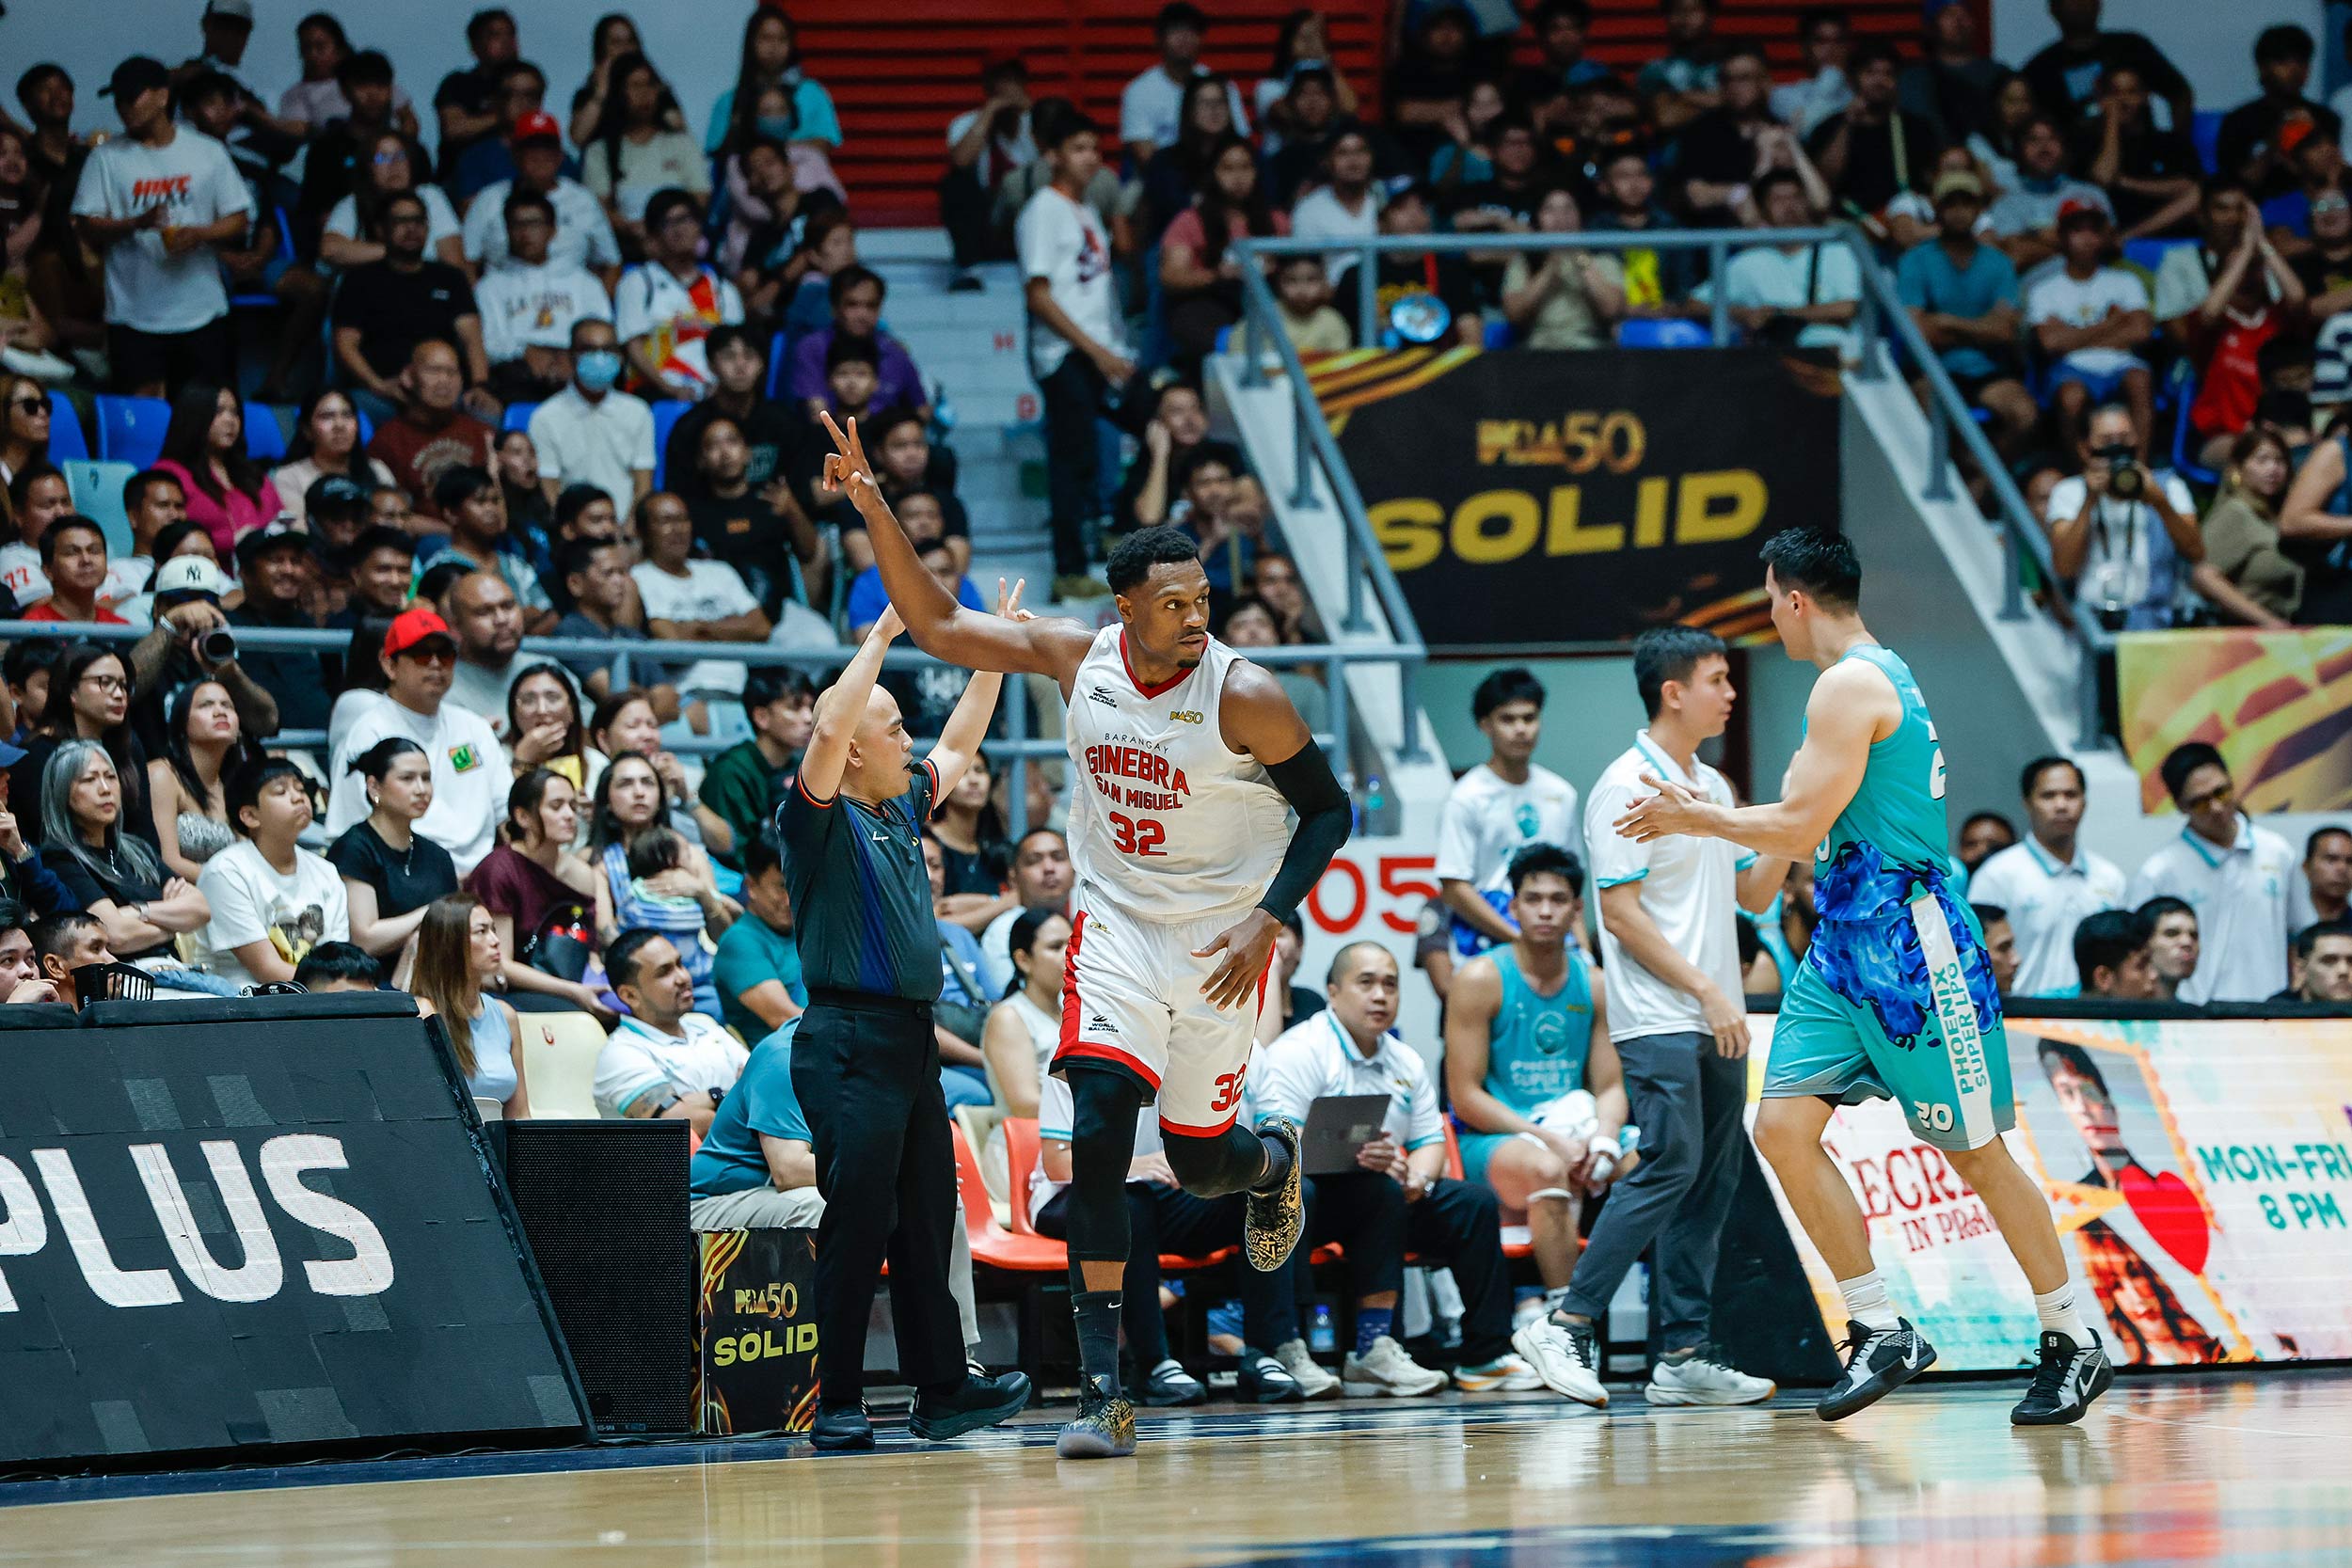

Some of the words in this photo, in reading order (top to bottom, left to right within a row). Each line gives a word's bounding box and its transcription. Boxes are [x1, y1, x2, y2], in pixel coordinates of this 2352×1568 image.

[1367, 468, 1769, 572] SOLID
[1089, 695, 1118, 708] BALANCE
[1092, 691, 1116, 704] WORLD
[1104, 733, 1169, 754] BARANGAY
[1085, 745, 1191, 796] GINEBRA
[1094, 774, 1121, 804] SAN
[1125, 788, 1184, 810] MIGUEL
[1108, 811, 1168, 856] 32
[1932, 967, 1975, 1095] PHOENIX
[1958, 1012, 1988, 1088] SUPER
[1211, 1063, 1247, 1112] 32
[1914, 1100, 1954, 1132] 20
[2196, 1143, 2352, 1182] MON-FRI
[2258, 1193, 2287, 1230] 8
[2286, 1192, 2347, 1229] PM
[1901, 1216, 1933, 1252] IN
[735, 1282, 798, 1319] PBA50
[714, 1323, 818, 1367] SOLID
